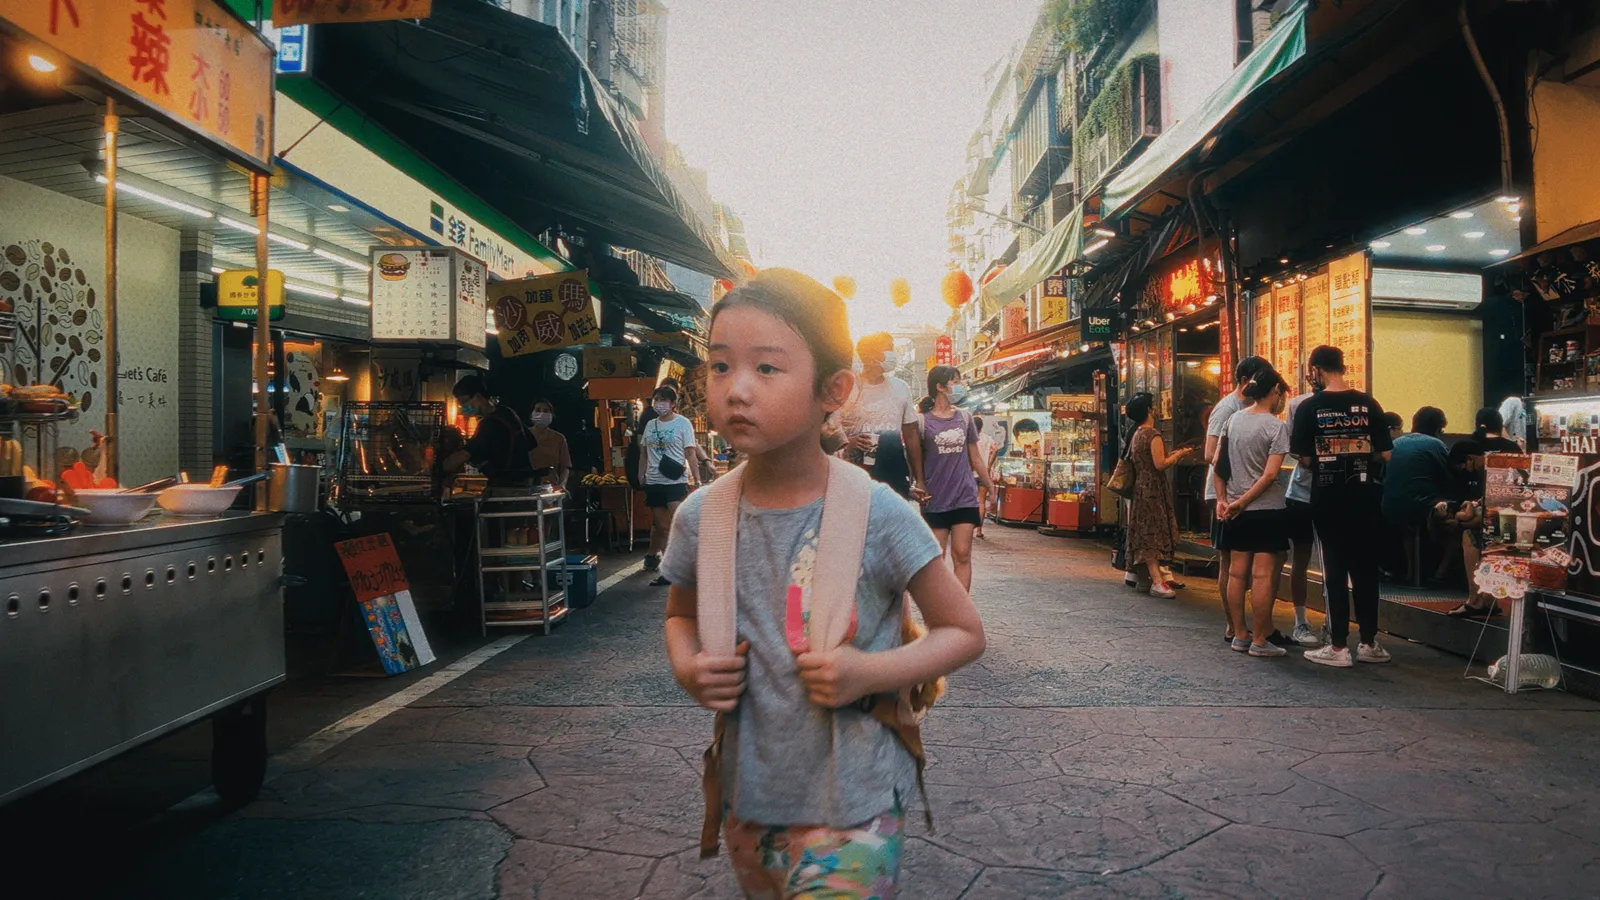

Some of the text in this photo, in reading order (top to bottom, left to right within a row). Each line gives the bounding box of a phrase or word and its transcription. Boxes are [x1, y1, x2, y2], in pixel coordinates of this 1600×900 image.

[448, 214, 466, 247] 全家
[469, 227, 515, 277] FamilyMart
[524, 288, 554, 304] 加蛋
[241, 308, 259, 316] ATM
[567, 313, 598, 341] 加起士
[1088, 316, 1111, 326] Uber
[1089, 325, 1111, 334] Eats
[507, 329, 531, 354] 加肉
[117, 366, 168, 383] et's Café
[1316, 411, 1348, 419] BASKETBALL
[1317, 415, 1369, 429] SEASON
[1561, 436, 1598, 454] THAI
